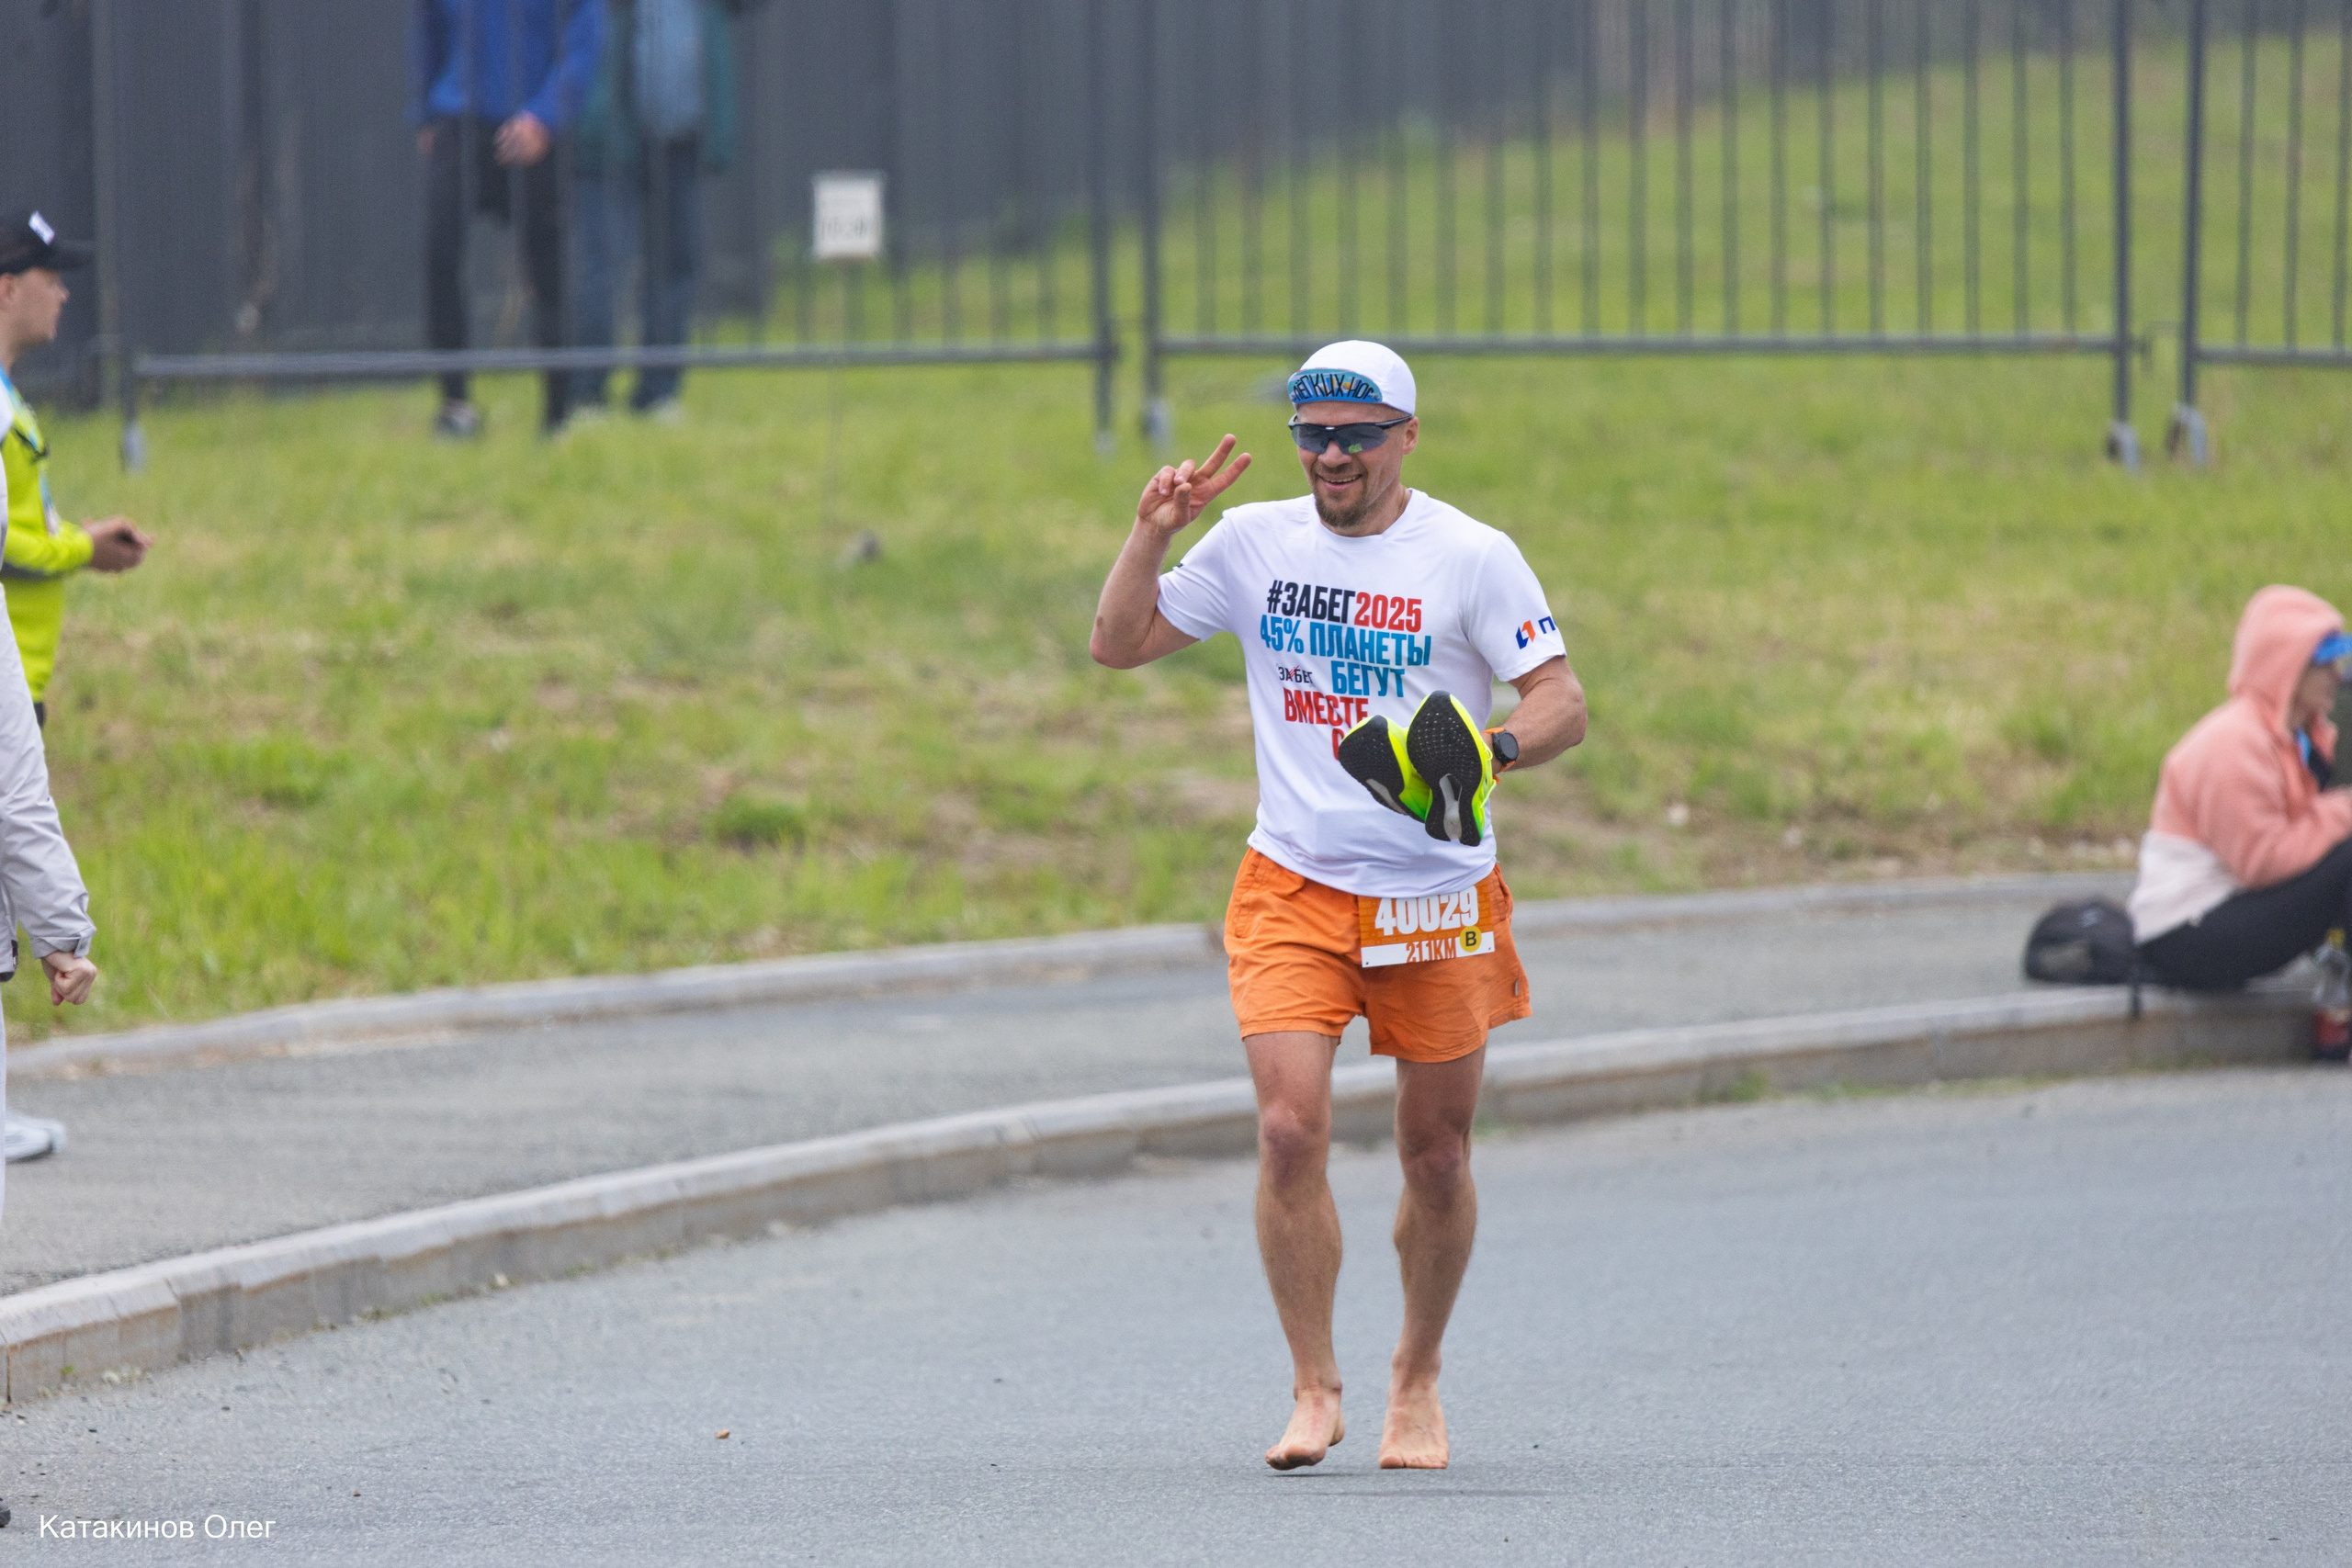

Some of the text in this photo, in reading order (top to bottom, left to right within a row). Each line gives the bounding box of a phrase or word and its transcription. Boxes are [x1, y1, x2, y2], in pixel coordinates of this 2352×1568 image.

[1347, 377, 1374, 400] НОГ
[1260, 615, 1431, 666] 45% ПЛАНЕТЫ
[1330, 660, 1405, 698] БЕГУТ
[1283, 687, 1369, 728] ВМЕСТЕ
[1374, 885, 1479, 936] 40029
[1465, 931, 1477, 947] B
